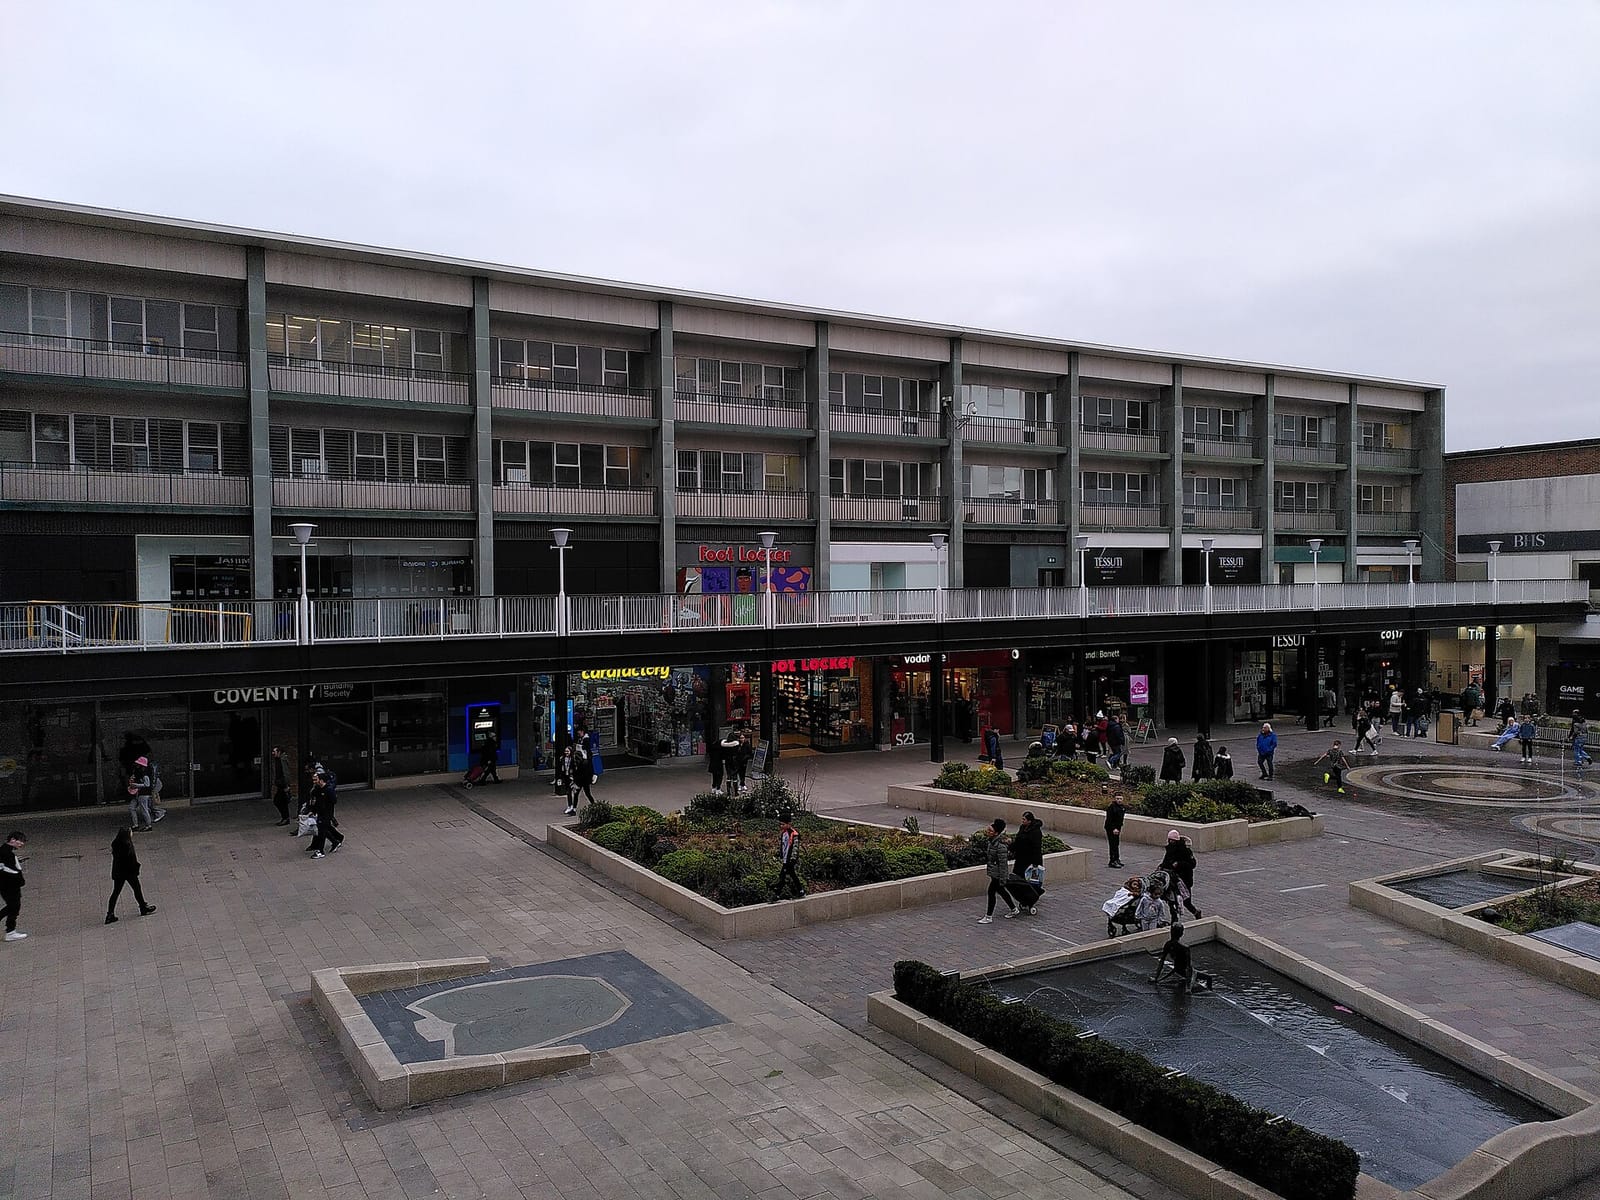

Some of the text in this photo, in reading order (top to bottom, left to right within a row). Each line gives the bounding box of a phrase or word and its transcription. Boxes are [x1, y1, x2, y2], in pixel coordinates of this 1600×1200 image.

[1512, 533, 1545, 547] BHS
[698, 545, 791, 562] Foot Locker
[1093, 557, 1123, 567] TESSUTI
[1218, 556, 1244, 566] TESSUTI
[1468, 629, 1501, 640] Thre
[1559, 685, 1585, 694] GAME
[895, 732, 915, 746] S23
